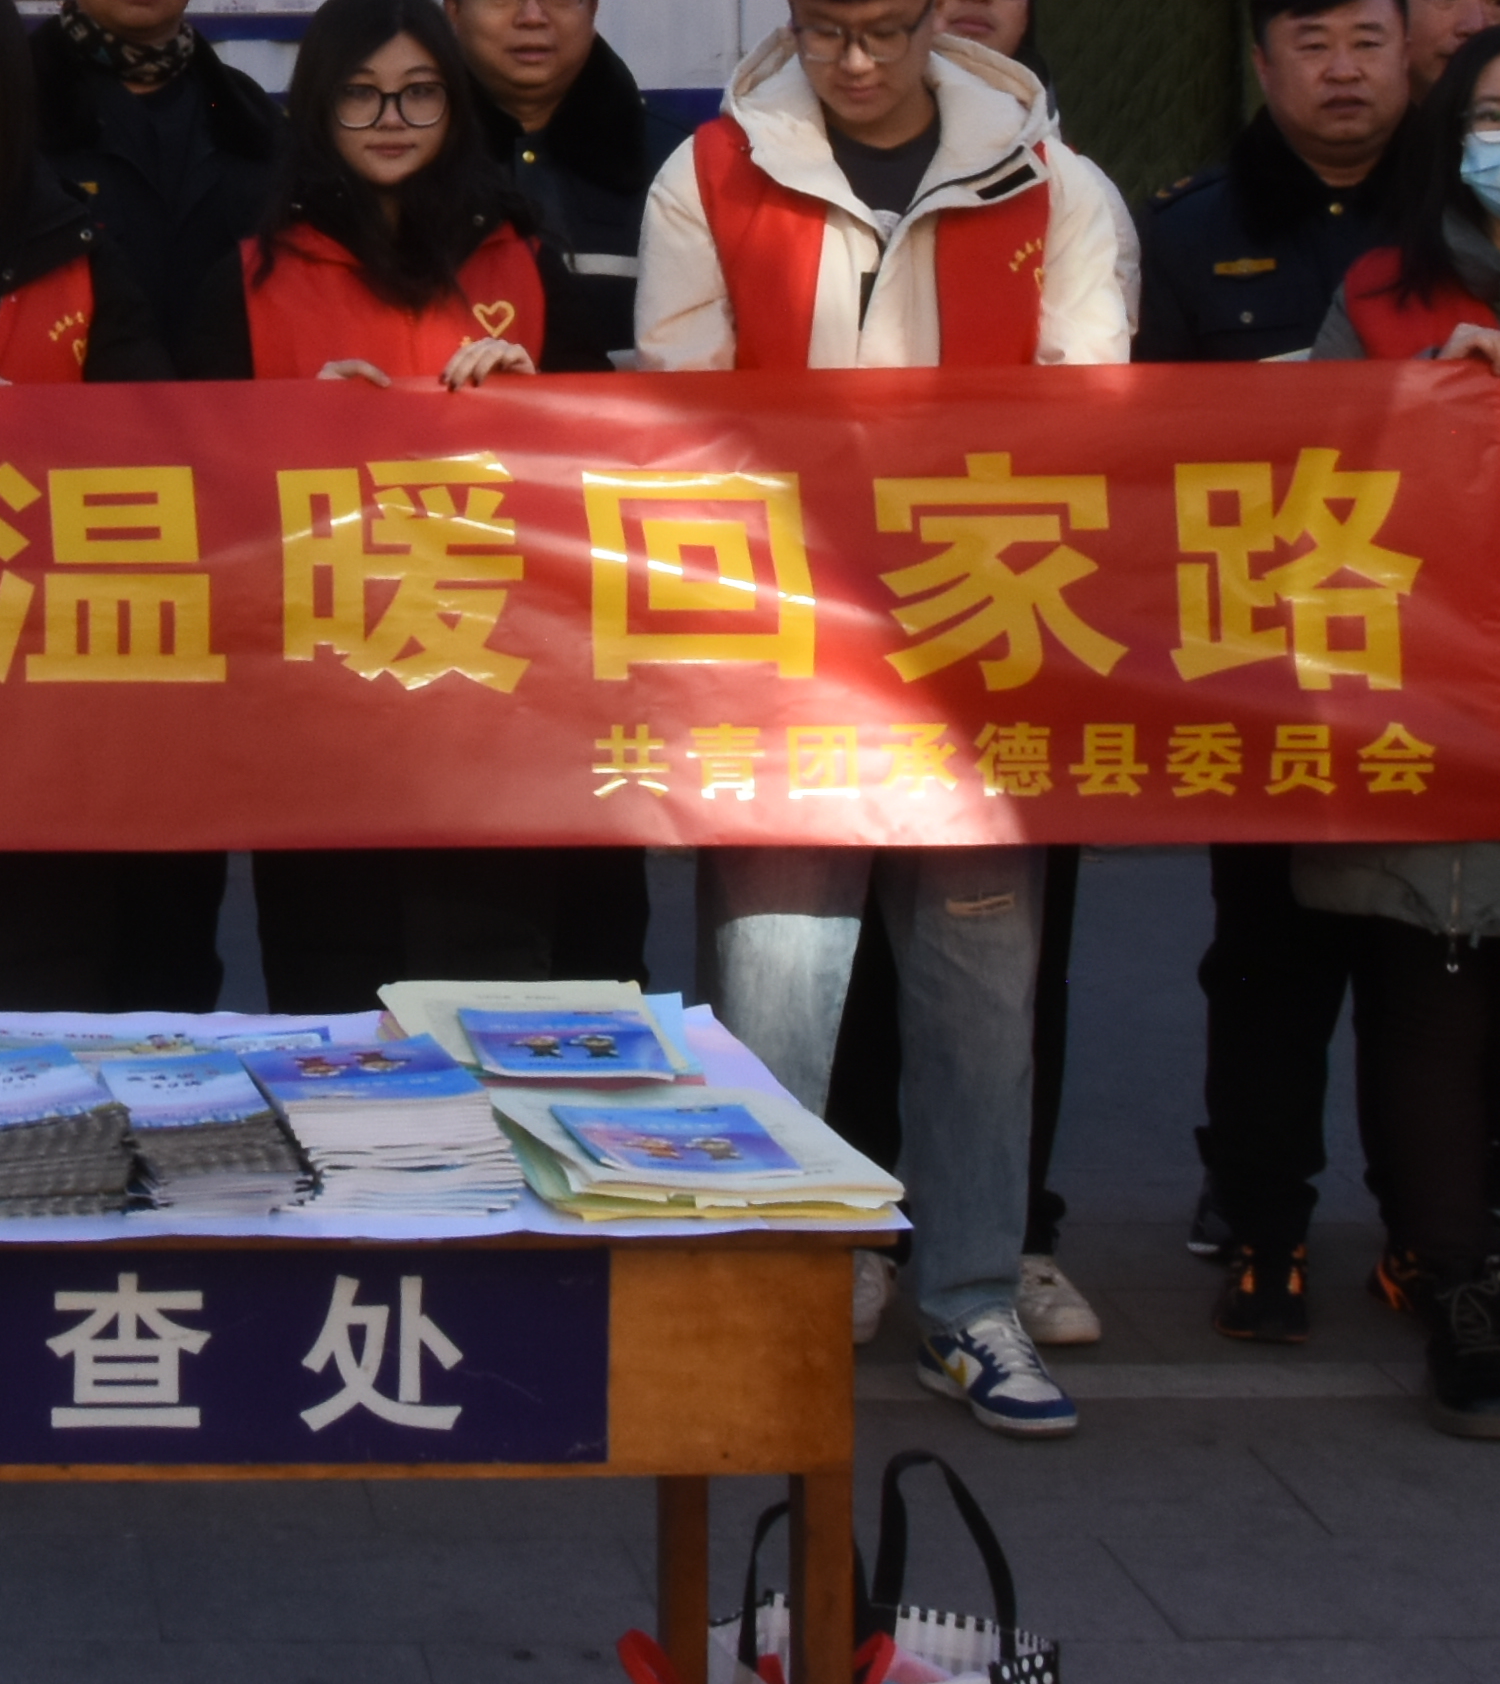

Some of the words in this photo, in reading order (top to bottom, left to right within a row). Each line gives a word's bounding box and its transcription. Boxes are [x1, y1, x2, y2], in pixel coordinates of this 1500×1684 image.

[591, 720, 1438, 800] 共青团承德县委员会
